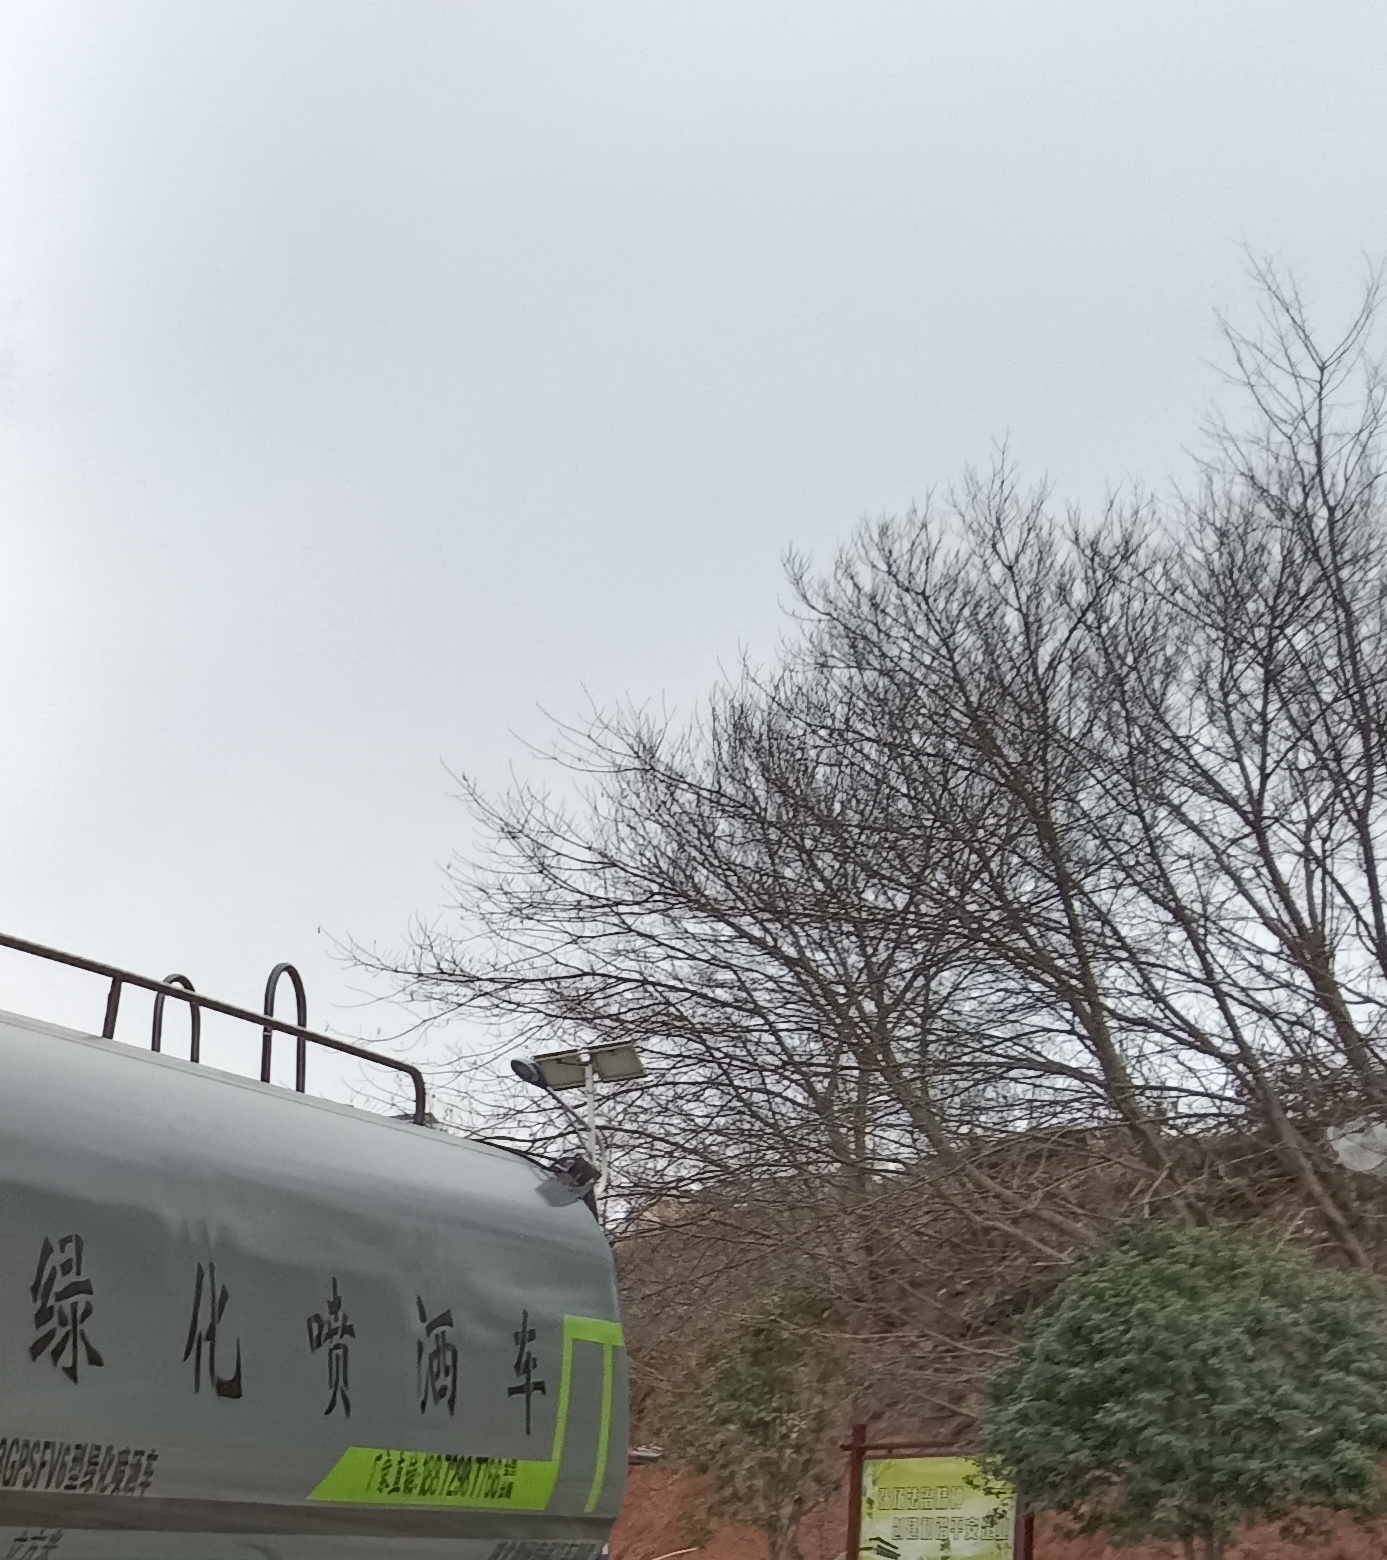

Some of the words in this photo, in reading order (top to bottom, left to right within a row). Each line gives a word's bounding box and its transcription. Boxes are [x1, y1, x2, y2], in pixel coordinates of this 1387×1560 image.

[29, 1234, 547, 1436] 绿化喷洒车
